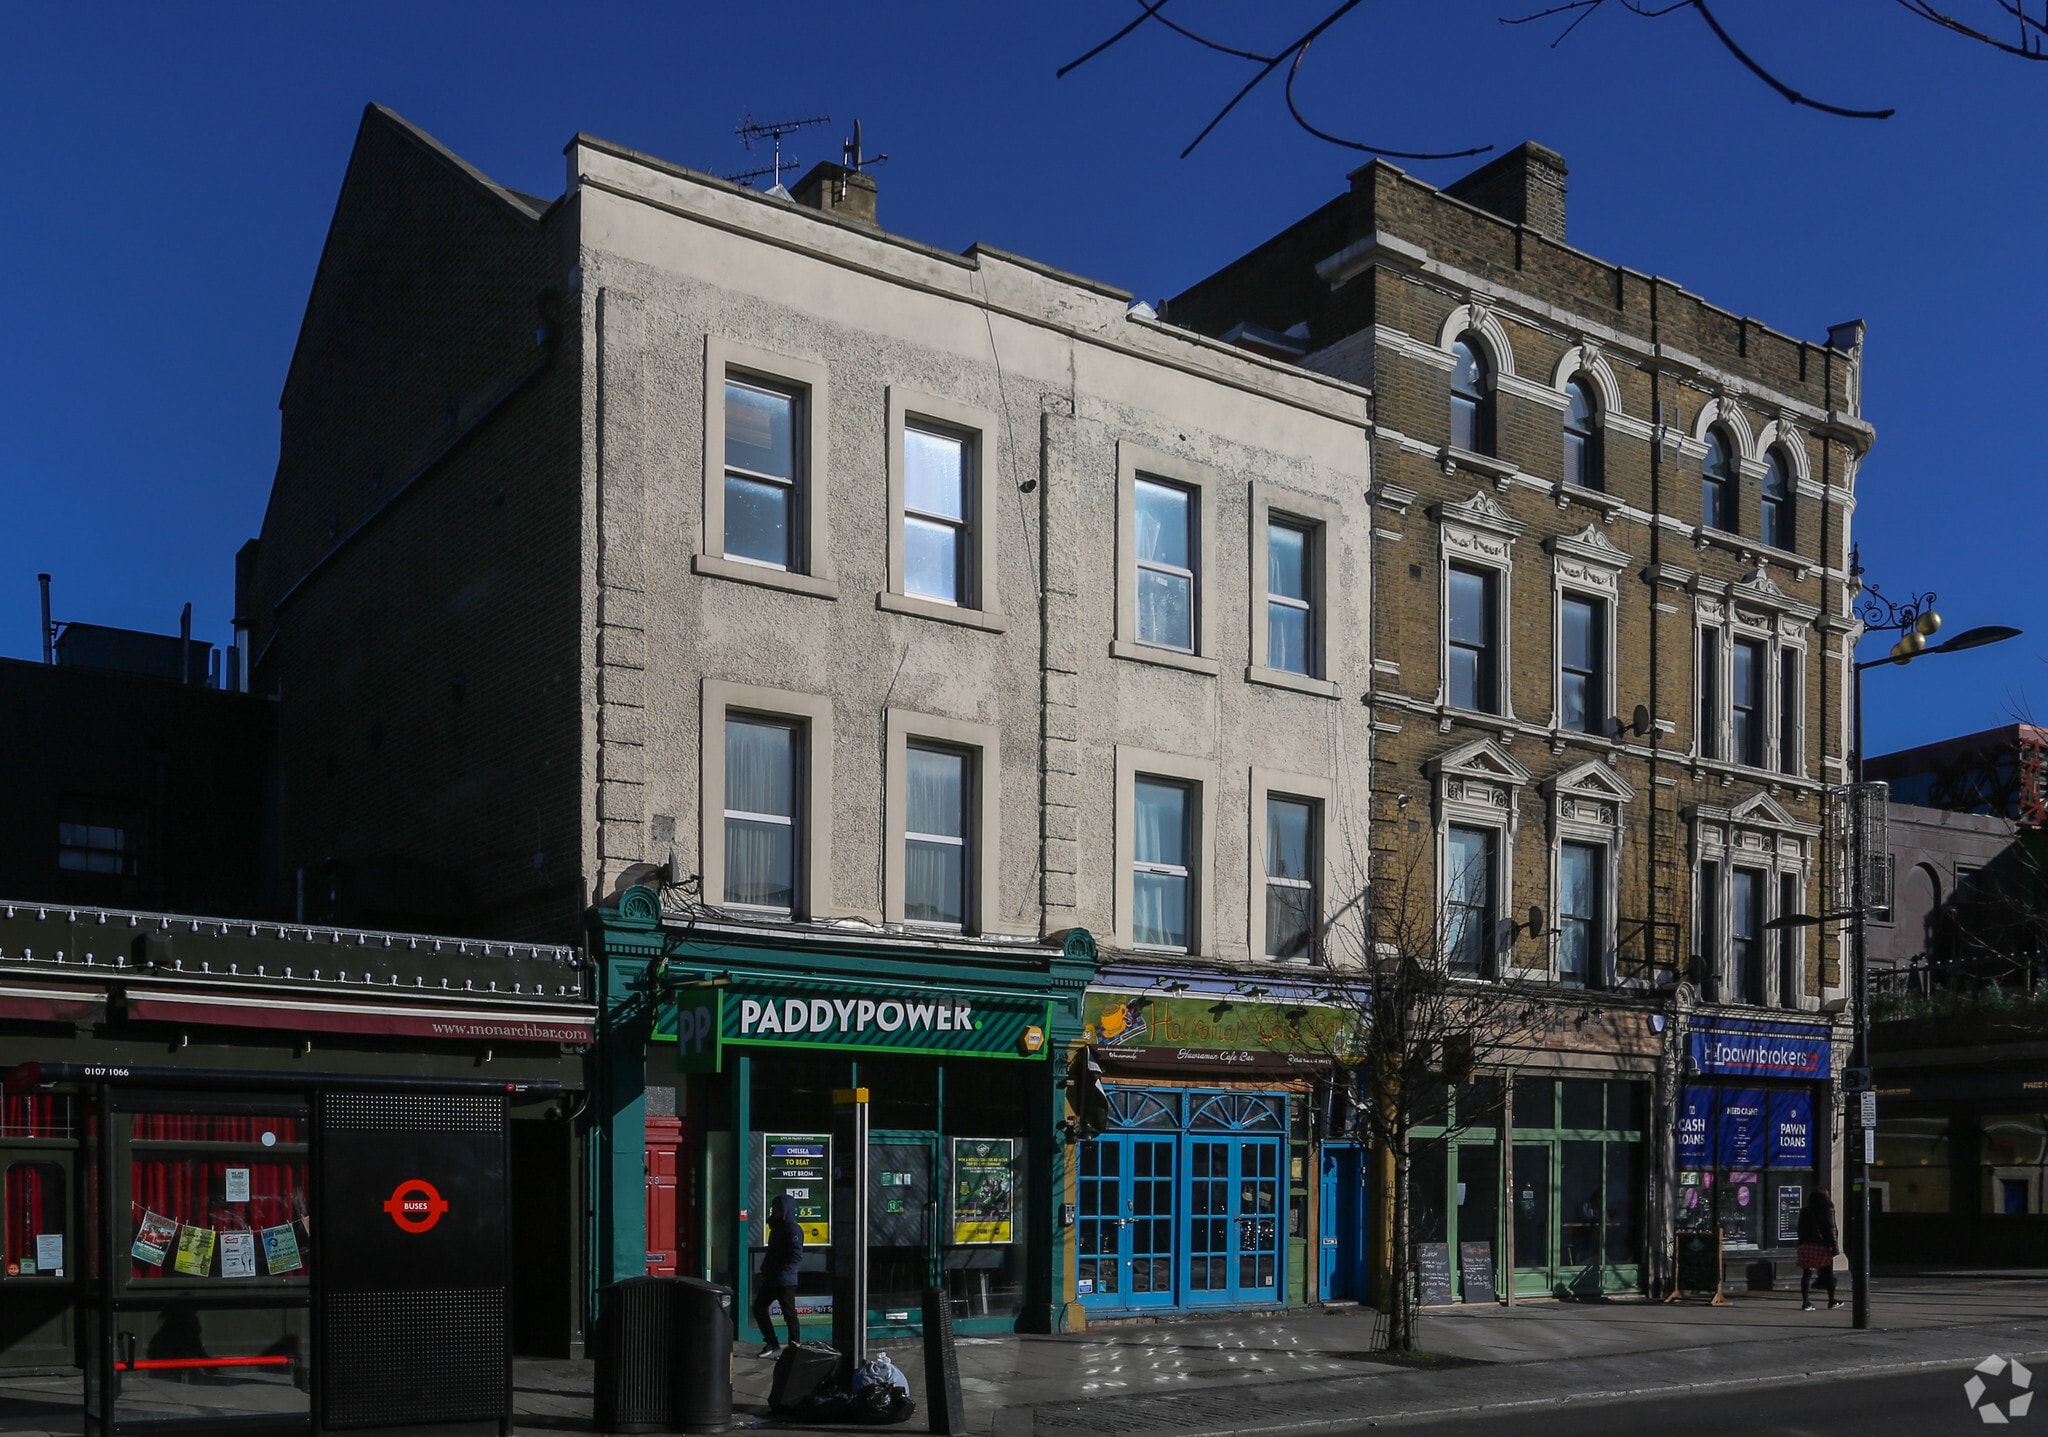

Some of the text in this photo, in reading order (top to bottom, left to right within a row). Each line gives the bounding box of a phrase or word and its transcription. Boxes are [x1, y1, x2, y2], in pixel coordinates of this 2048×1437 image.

[432, 1024, 588, 1040] www.monarchbar.com
[1722, 1046, 1807, 1067] pawnbrokers
[85, 1067, 129, 1077] 0107 1066
[1727, 1107, 1741, 1115] NEED
[1678, 1119, 1705, 1132] CASH
[1780, 1123, 1806, 1135] PAWN
[1678, 1134, 1705, 1145] LOANS
[1780, 1136, 1806, 1148] LOANS
[649, 1176, 660, 1185] 39
[404, 1202, 428, 1210] BUSES
